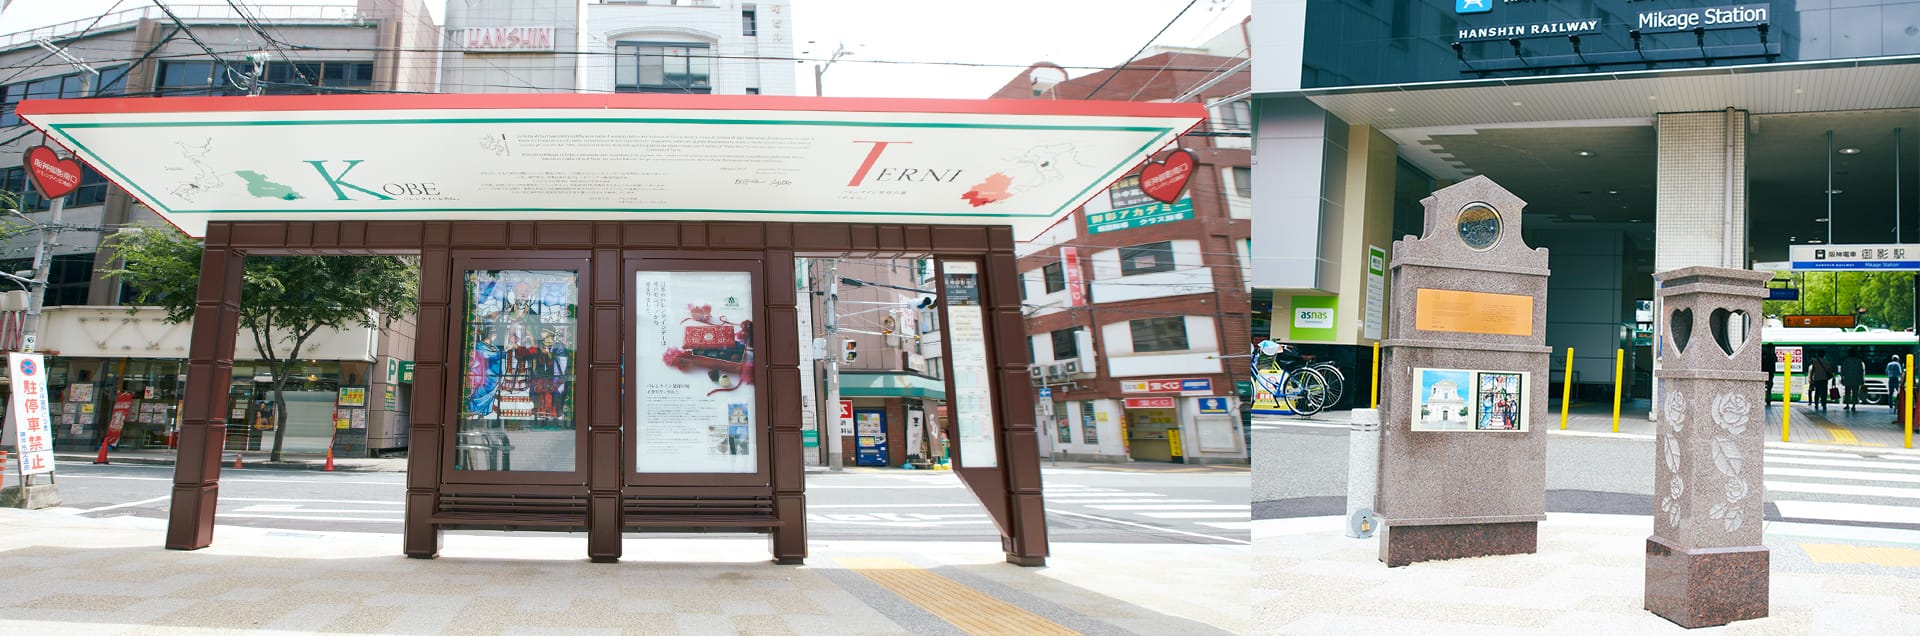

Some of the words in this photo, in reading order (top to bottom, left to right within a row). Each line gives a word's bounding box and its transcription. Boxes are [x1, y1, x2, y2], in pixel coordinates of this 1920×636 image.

[1639, 12, 1699, 29] Mikage
[1704, 7, 1766, 24] Station
[467, 28, 550, 48] HANSHIN
[1459, 26, 1525, 39] HANSHIN
[1531, 21, 1597, 34] RAILWAY
[847, 141, 964, 187] TERNI
[302, 159, 440, 200] KOBE
[1862, 248, 1905, 259] 御影駅
[1300, 311, 1328, 320] asnas
[388, 359, 396, 381] P
[23, 380, 46, 470] 駐停車禁止
